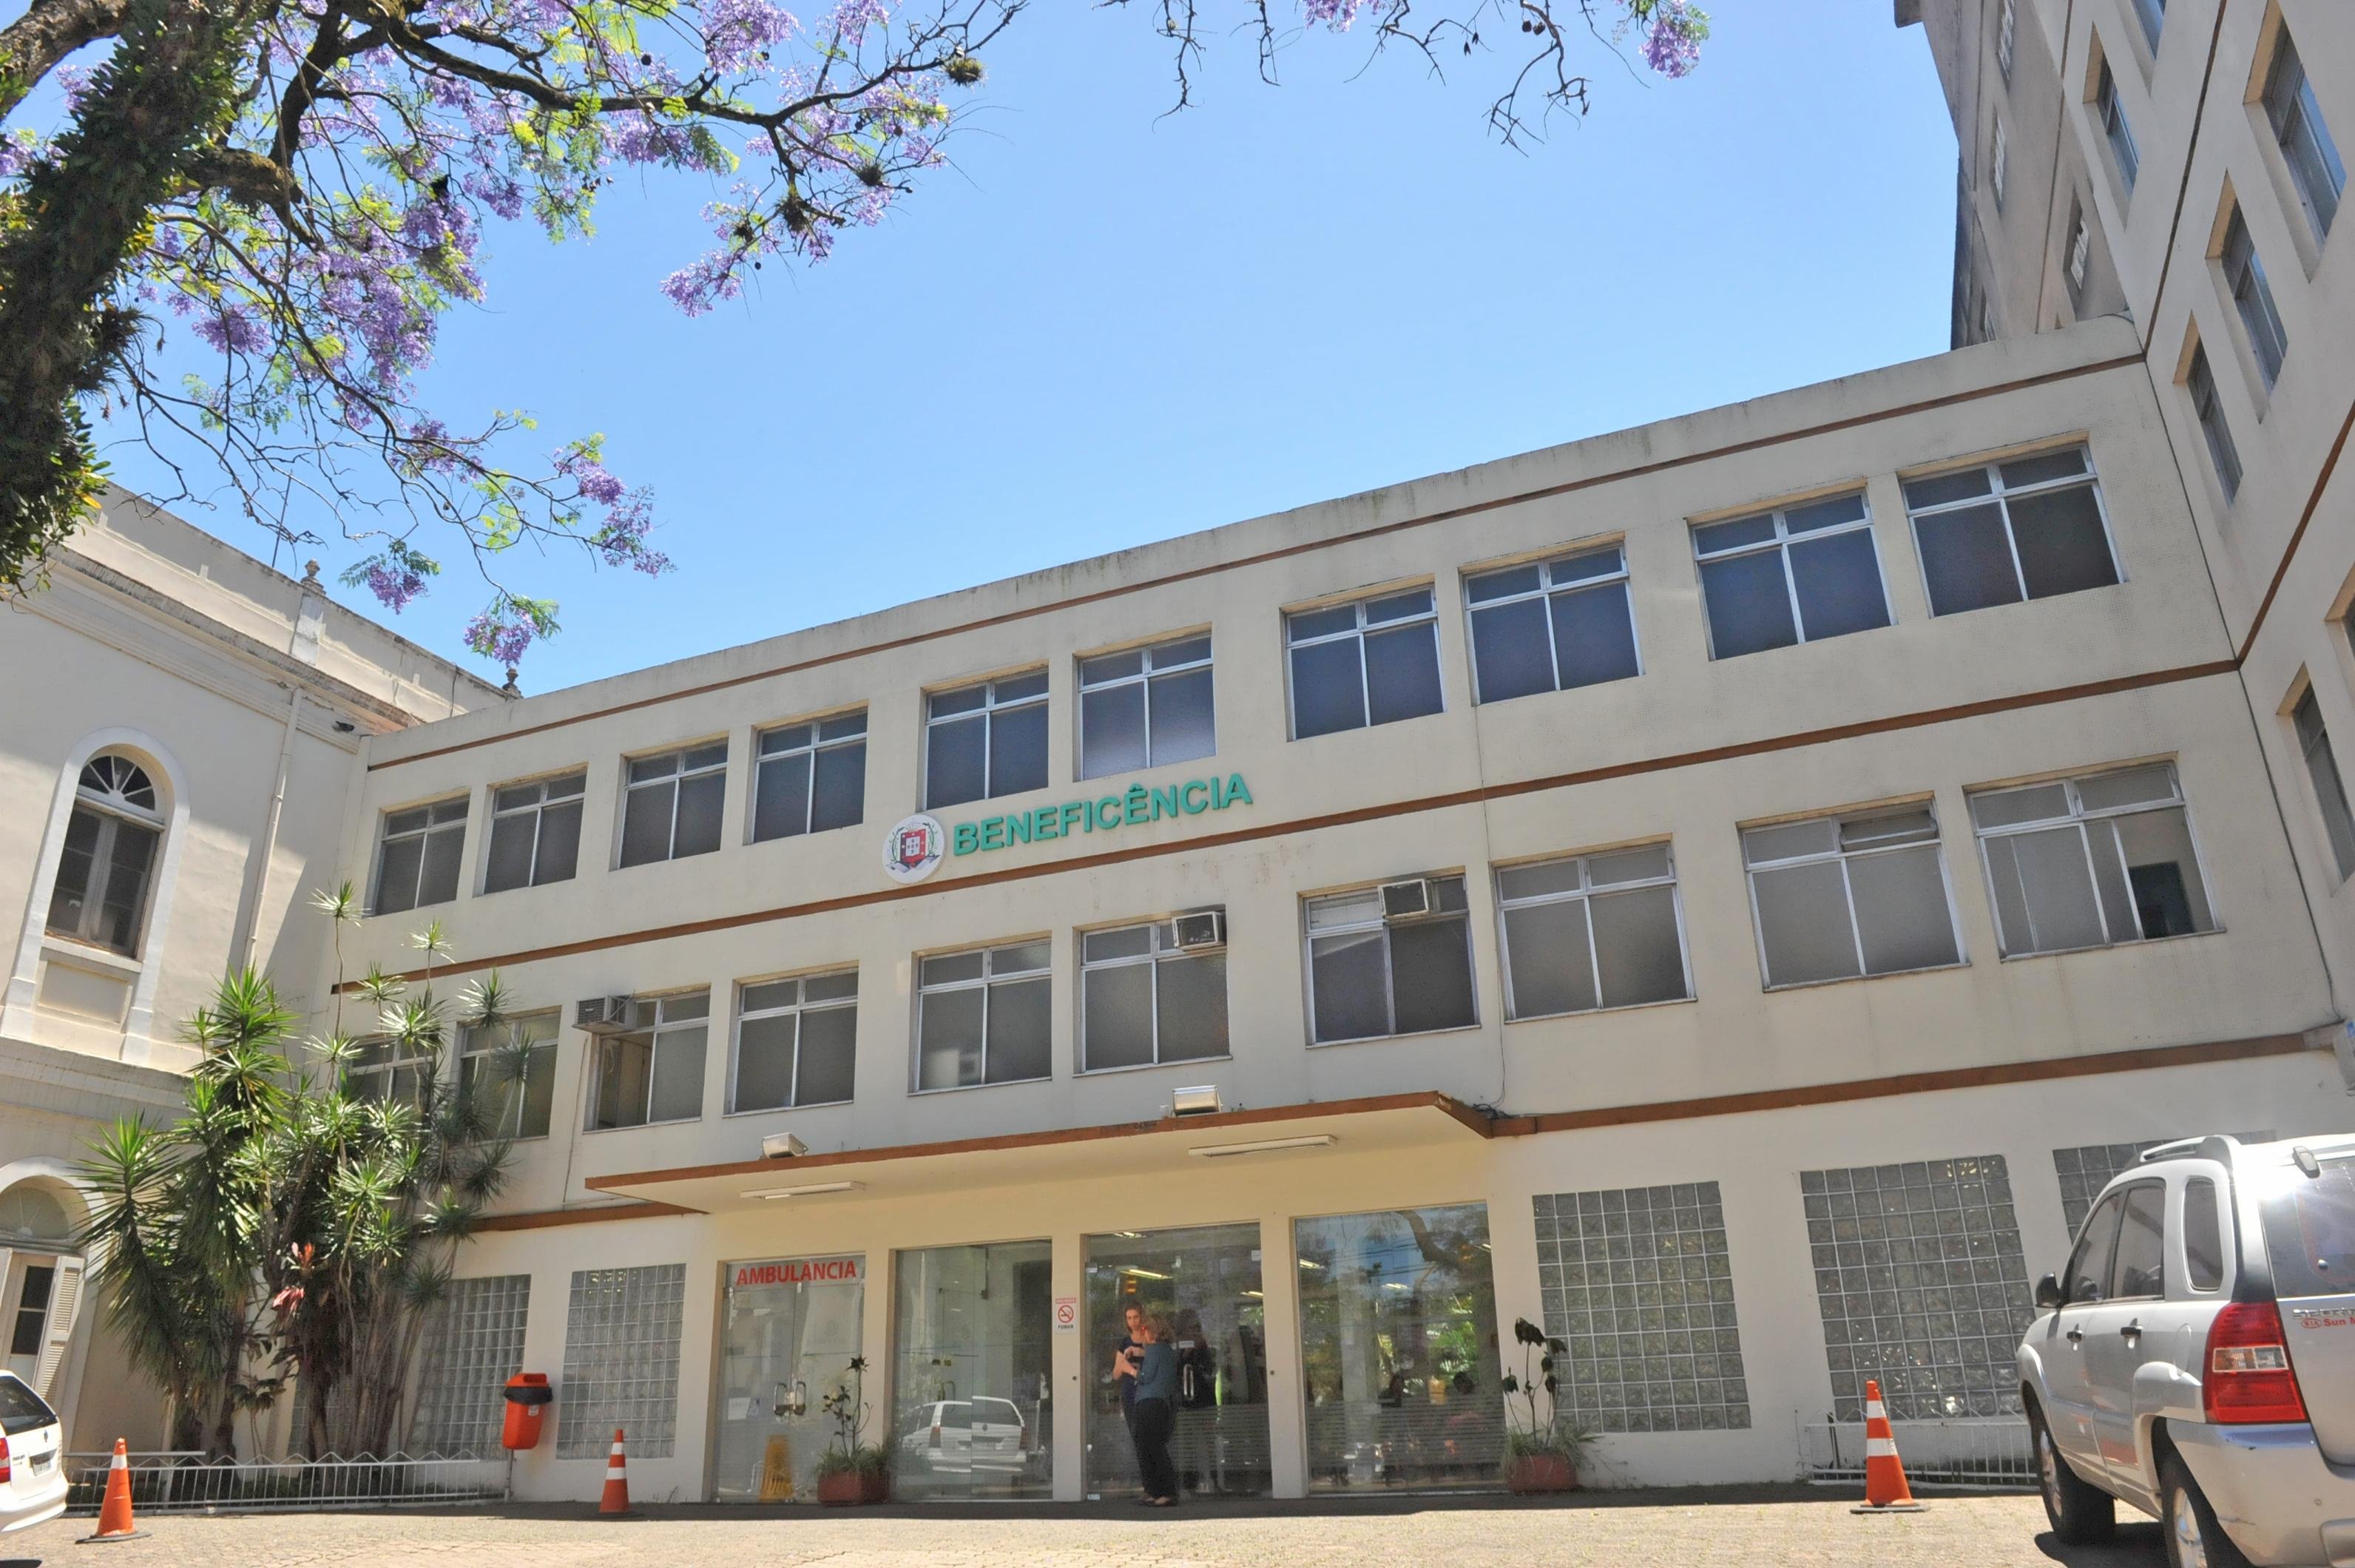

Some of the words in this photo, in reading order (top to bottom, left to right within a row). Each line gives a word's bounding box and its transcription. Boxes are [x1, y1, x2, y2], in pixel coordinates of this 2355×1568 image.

[953, 773, 1253, 856] BENEFICÊNCIA
[736, 1260, 857, 1285] AMBULÂNCIA
[2324, 1318, 2346, 1326] Sun
